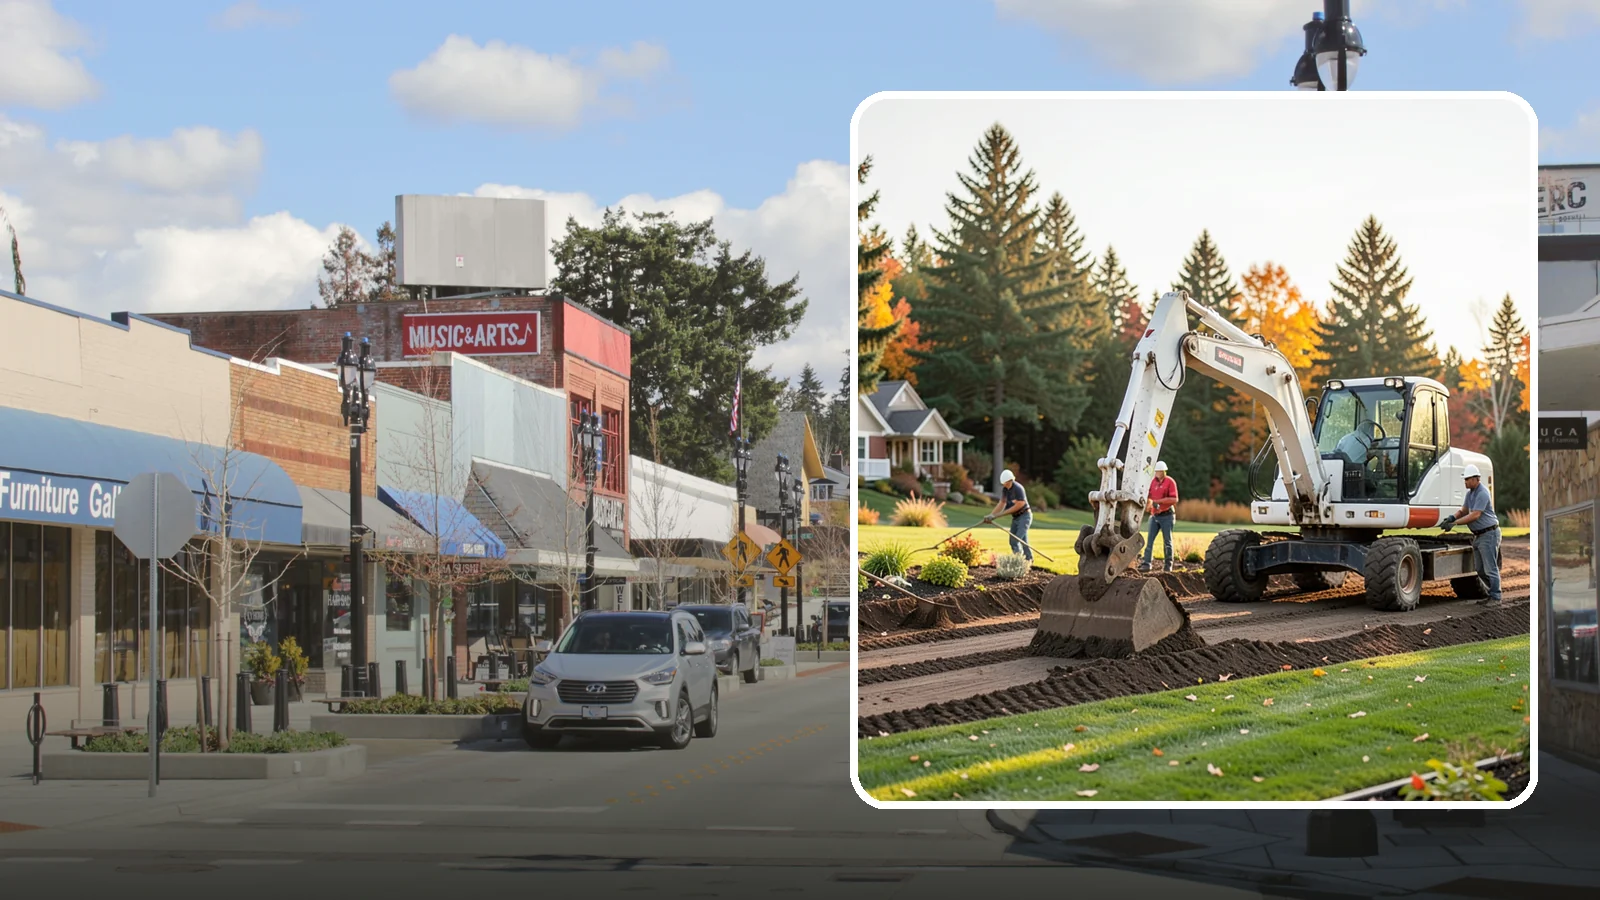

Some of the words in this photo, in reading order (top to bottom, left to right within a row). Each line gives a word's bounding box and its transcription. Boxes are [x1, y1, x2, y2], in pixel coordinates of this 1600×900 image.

[1540, 427, 1577, 437] UGA
[0, 471, 79, 515] Furniture
[90, 482, 122, 519] Gal
[453, 562, 479, 574] SUSHI
